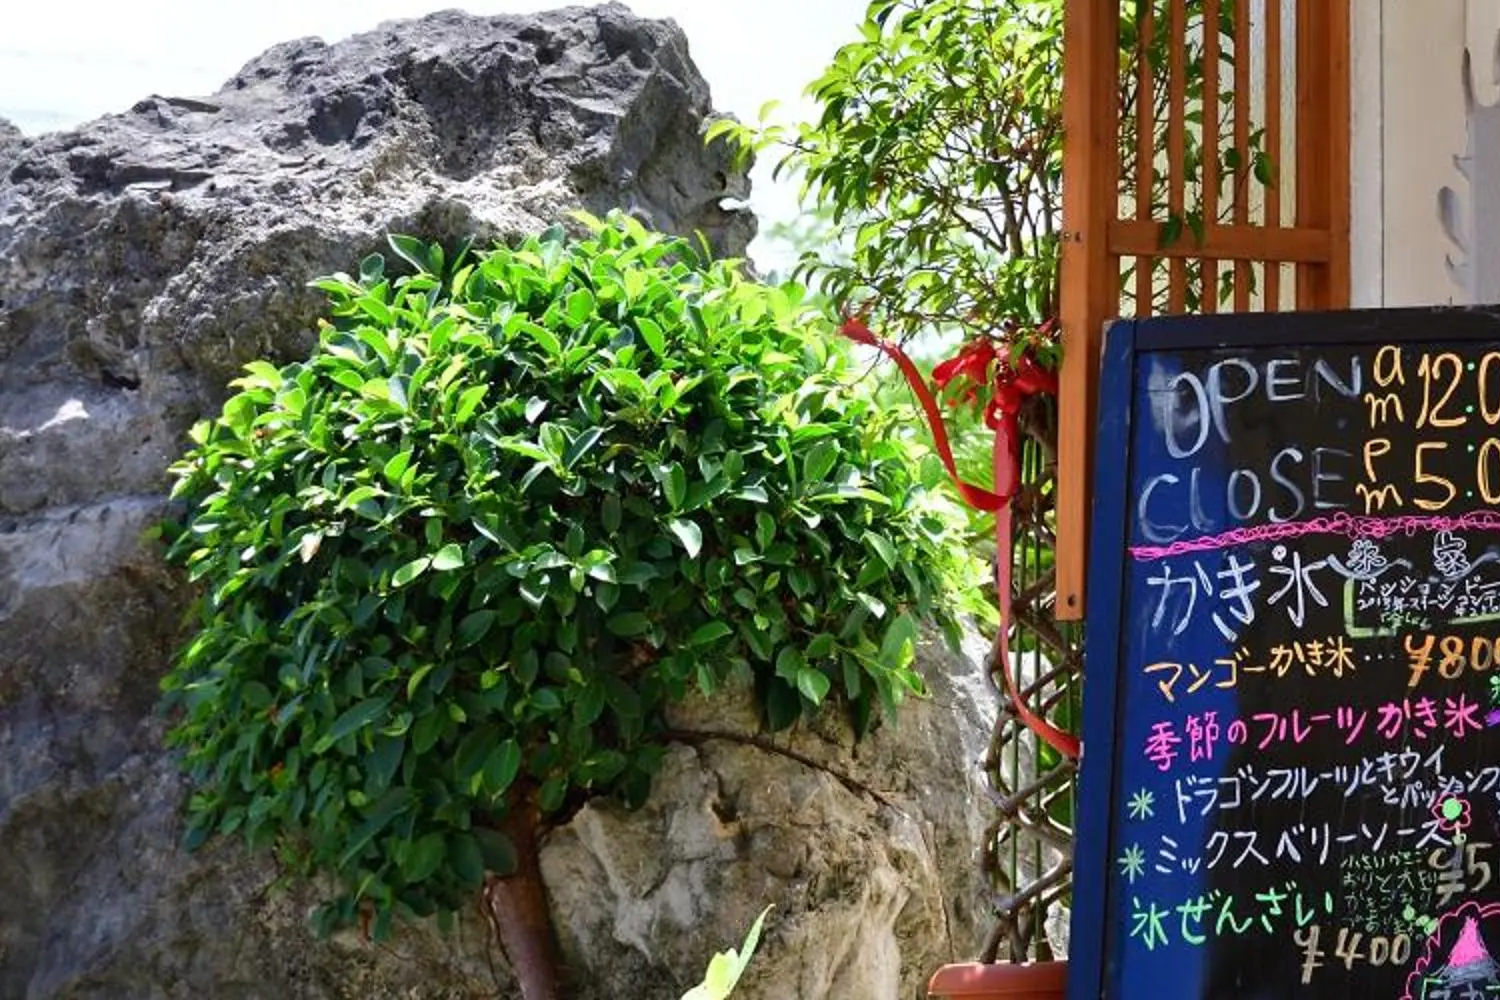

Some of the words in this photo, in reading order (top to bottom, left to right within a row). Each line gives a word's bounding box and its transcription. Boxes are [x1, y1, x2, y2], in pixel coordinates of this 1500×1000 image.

[1164, 356, 1363, 460] OPEN
[1137, 446, 1352, 545] CLOSE
[1146, 544, 1329, 643] かき氷
[1154, 817, 1452, 875] ミックスベリーソース
[1129, 880, 1334, 953] 氷ぜんざい
[1294, 925, 1412, 985] ¥400
